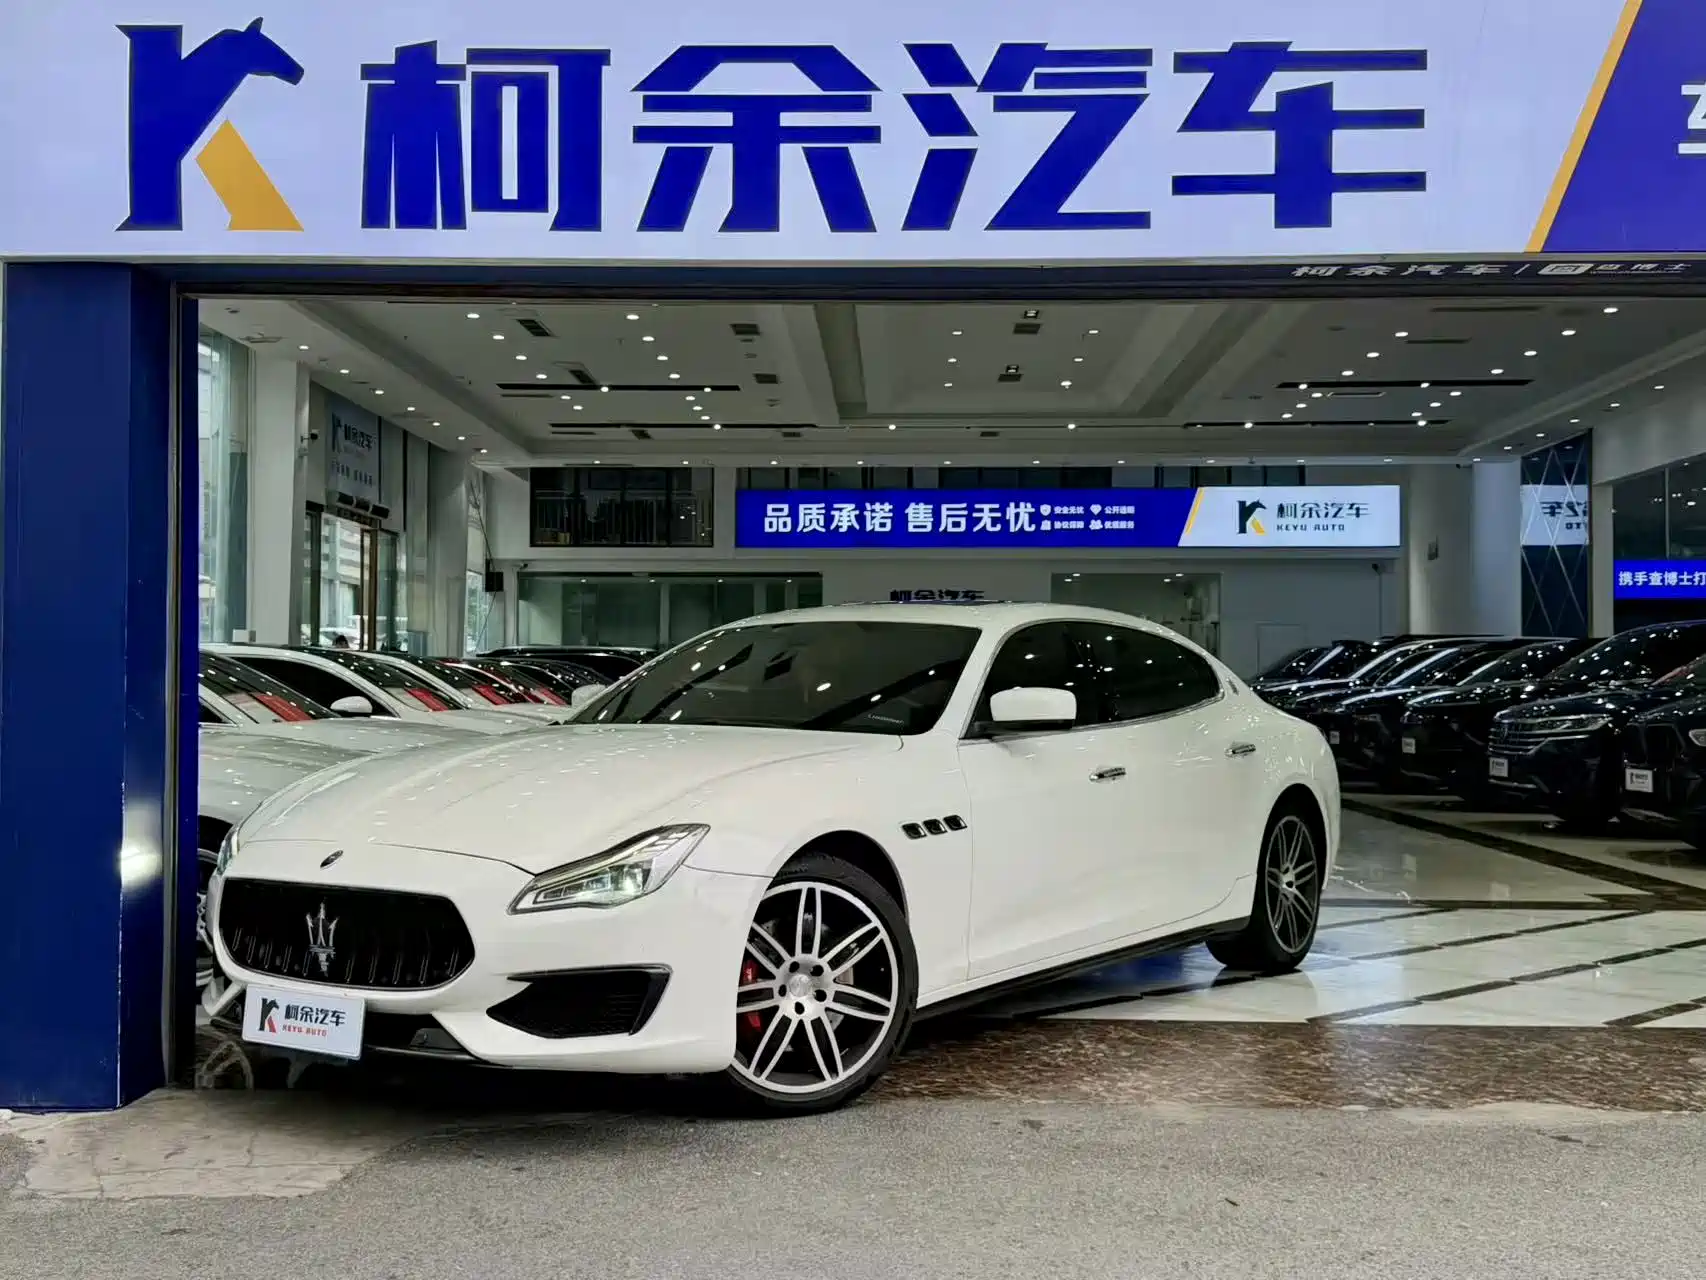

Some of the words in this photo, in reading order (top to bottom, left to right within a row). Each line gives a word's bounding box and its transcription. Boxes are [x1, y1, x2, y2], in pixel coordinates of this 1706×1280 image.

[361, 41, 1428, 231] 柯余汽车
[764, 503, 892, 532] 品质承诺
[905, 502, 1036, 532] 售后无忧
[1276, 502, 1370, 519] 柯余汽车
[1276, 523, 1307, 532] KEYU
[1314, 523, 1345, 532] AUTO
[285, 1004, 346, 1026] 柯余汽车
